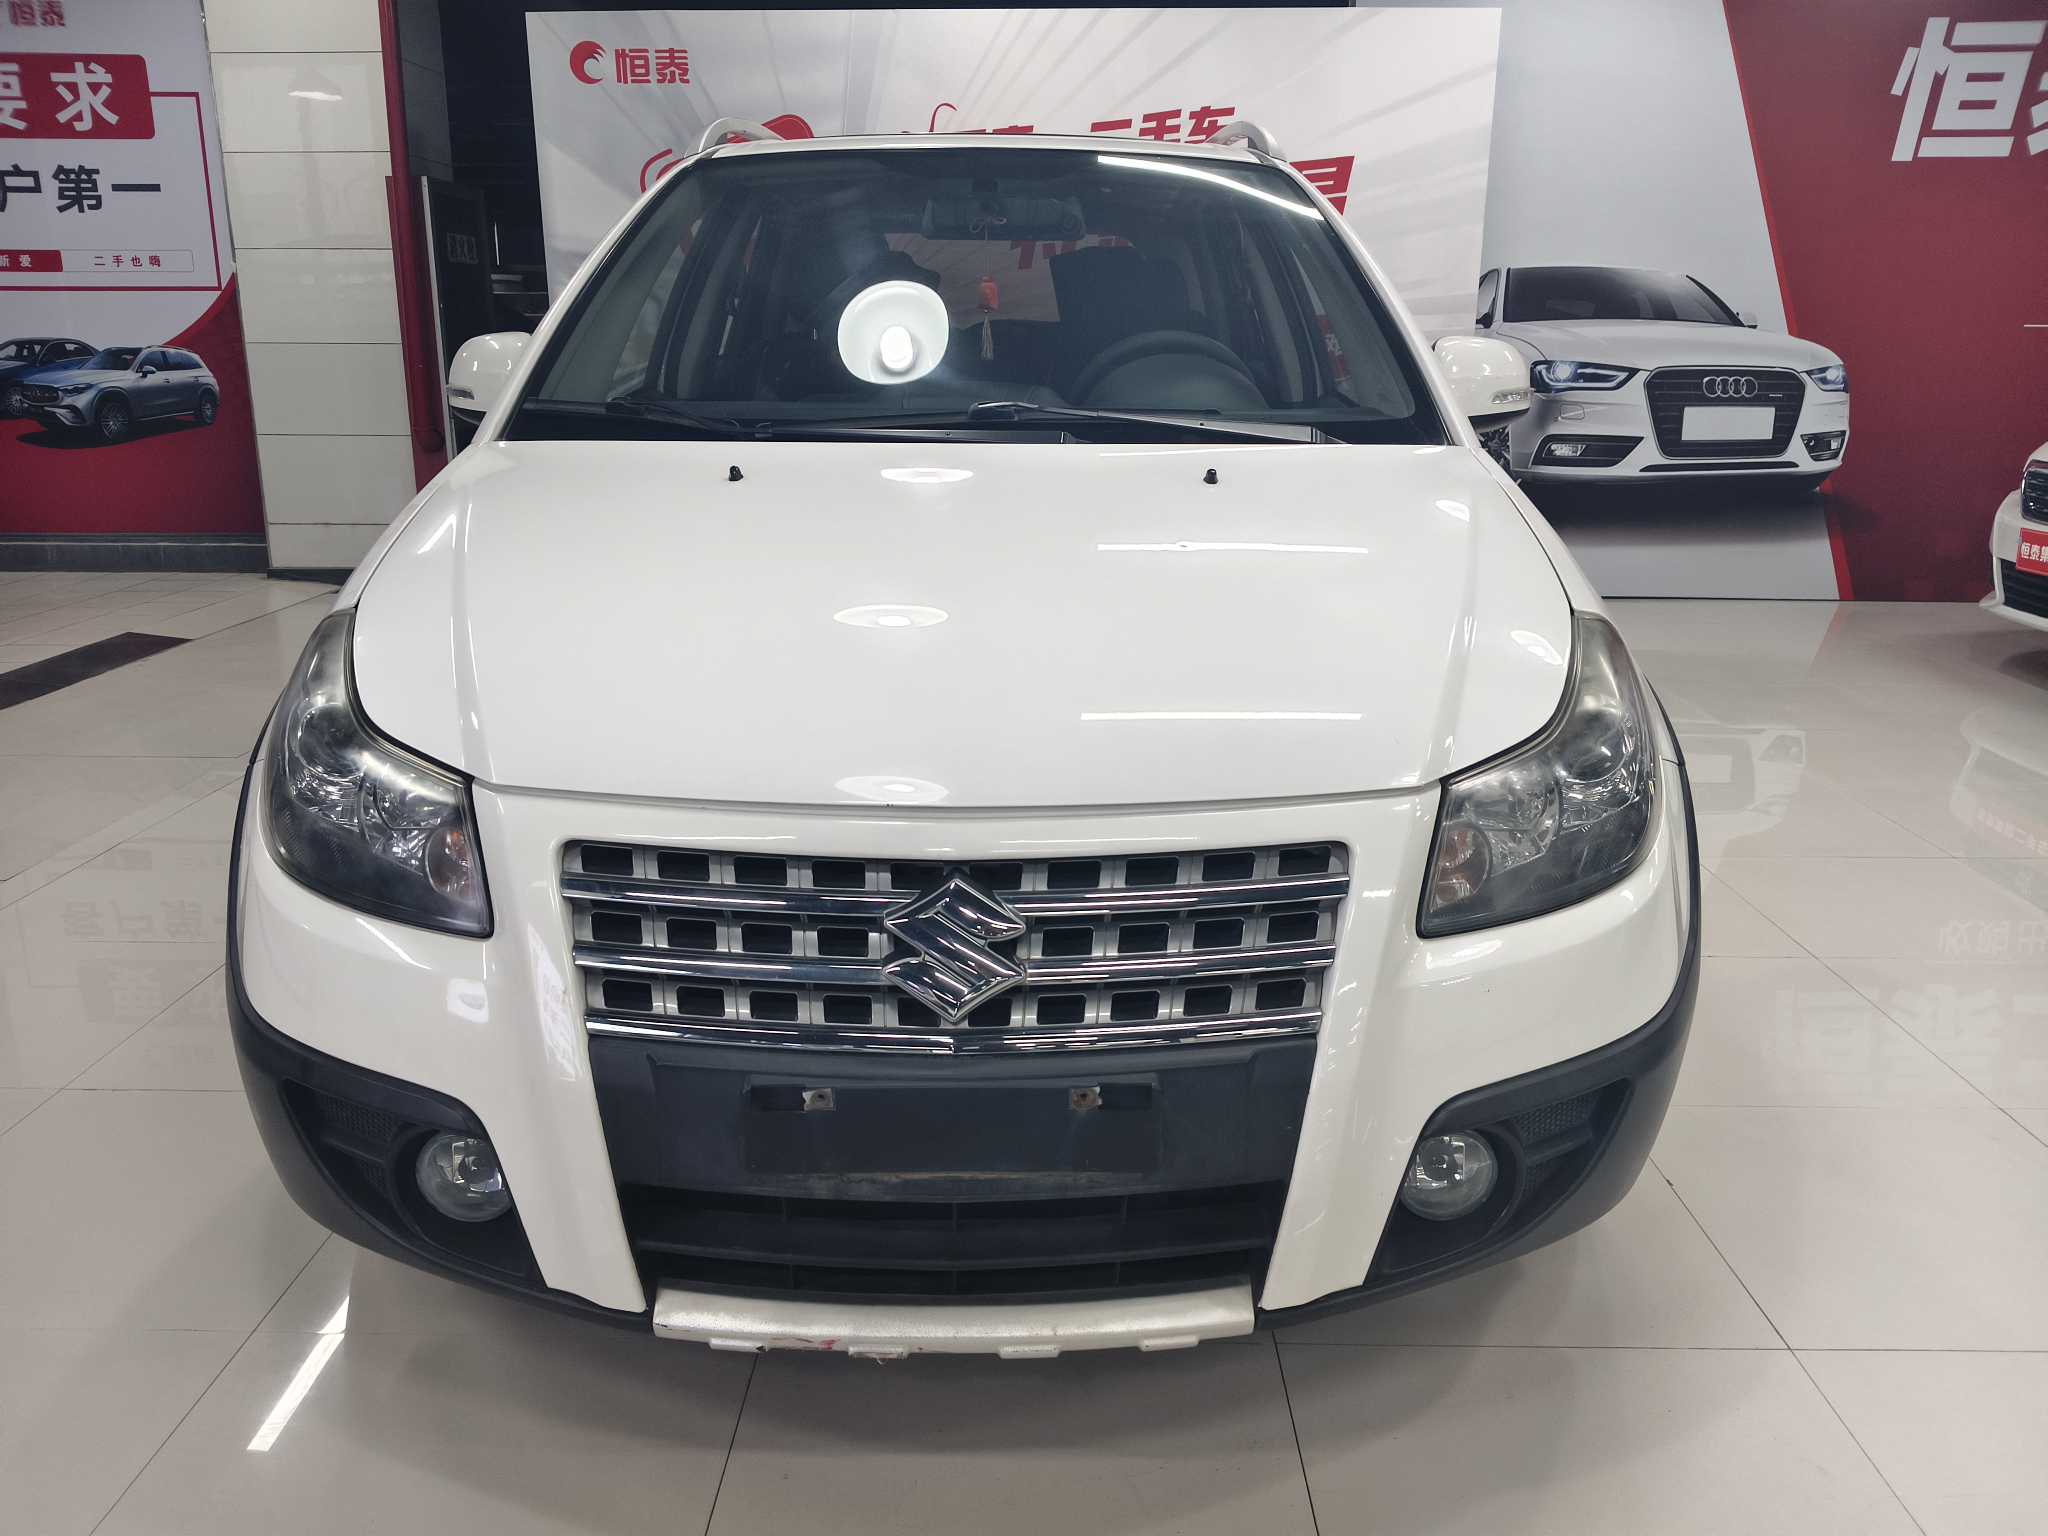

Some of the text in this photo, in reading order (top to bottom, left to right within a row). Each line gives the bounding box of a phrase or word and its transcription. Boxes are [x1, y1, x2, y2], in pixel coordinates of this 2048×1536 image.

[614, 48, 690, 84] 恒泰
[1890, 17, 2048, 161] 恒
[0, 163, 161, 213] 户第一
[94, 255, 161, 267] 二手也嗨
